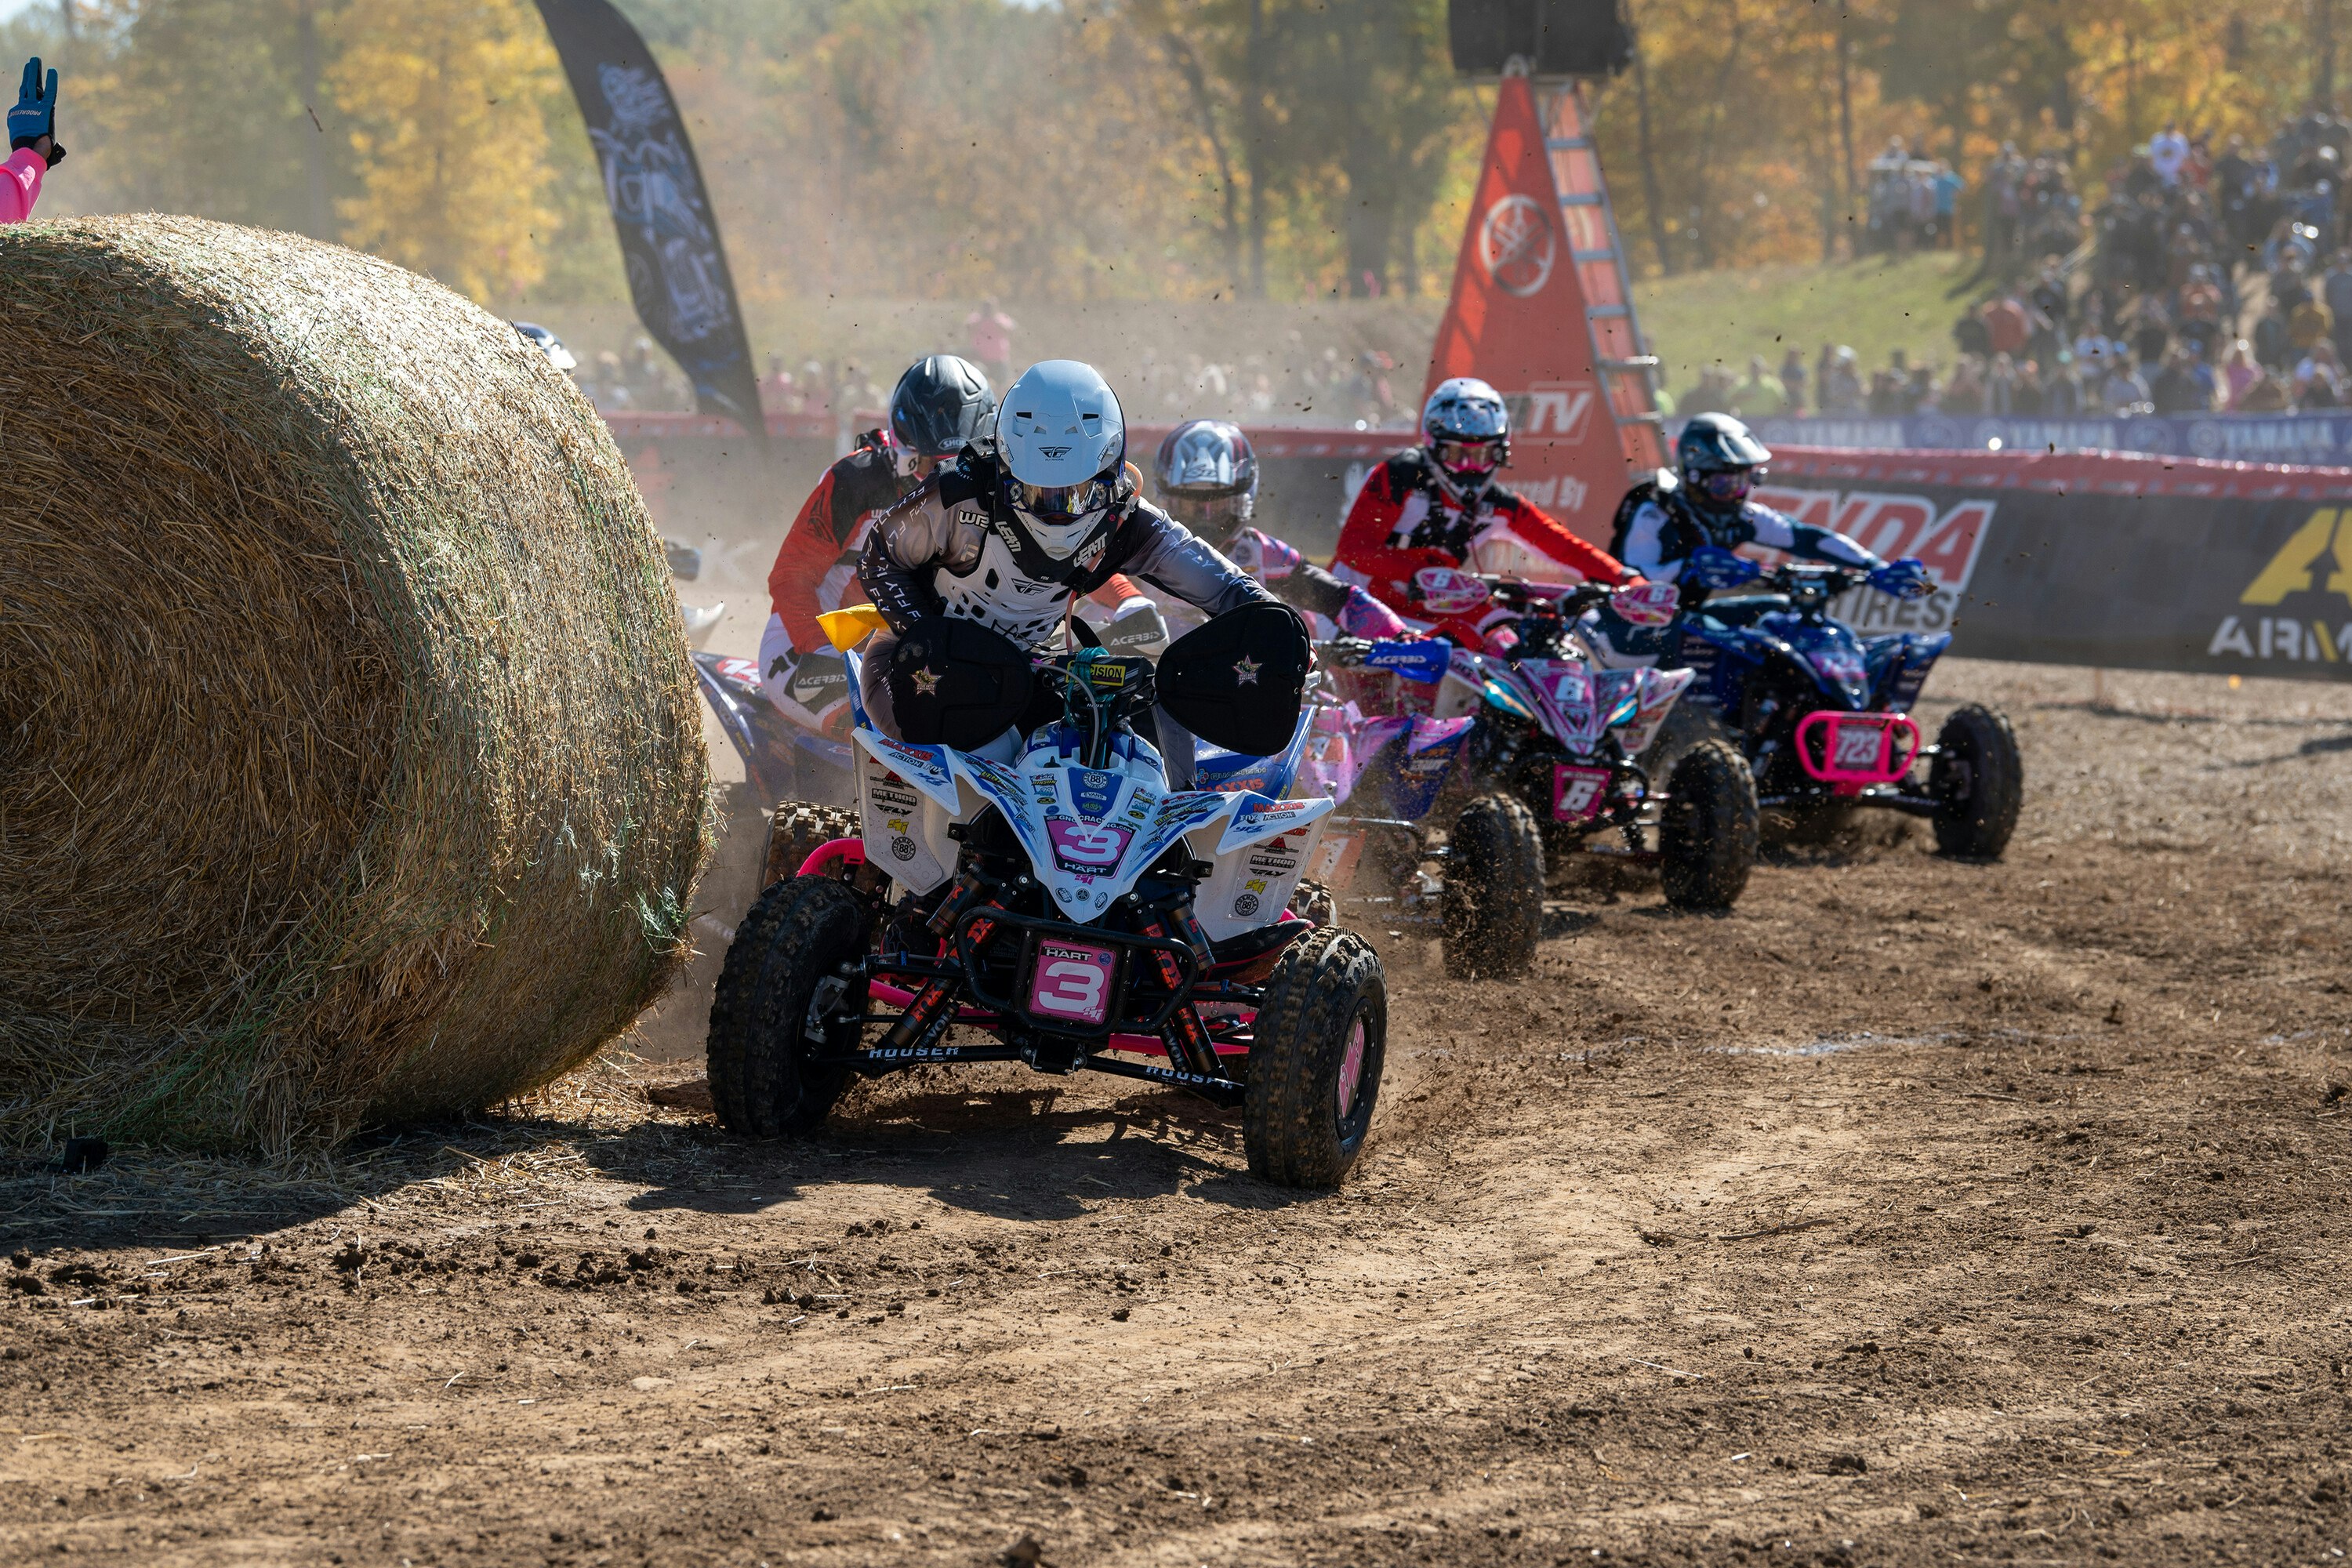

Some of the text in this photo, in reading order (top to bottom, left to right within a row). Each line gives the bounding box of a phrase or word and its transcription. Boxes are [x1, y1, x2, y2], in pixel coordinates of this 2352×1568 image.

[943, 439, 967, 448] SHO
[1742, 492, 1987, 584] ENDA
[1181, 547, 1215, 568] FLY
[1110, 631, 1160, 646] ACERBIS
[878, 739, 934, 761] MAXXIS
[1833, 729, 1881, 764] 723
[1091, 775, 1102, 783] 88
[873, 789, 916, 803] METHOD
[1254, 803, 1305, 812] MAXXIS
[899, 844, 909, 853] 88
[1058, 824, 1121, 862] 3
[1252, 855, 1294, 866] METHOD
[1064, 862, 1107, 873] HART
[1242, 901, 1252, 909] 88
[1046, 949, 1092, 961] HART
[1038, 961, 1105, 1013] 3
[909, 983, 944, 1022] FOX
[869, 1047, 960, 1058] HOUSER
